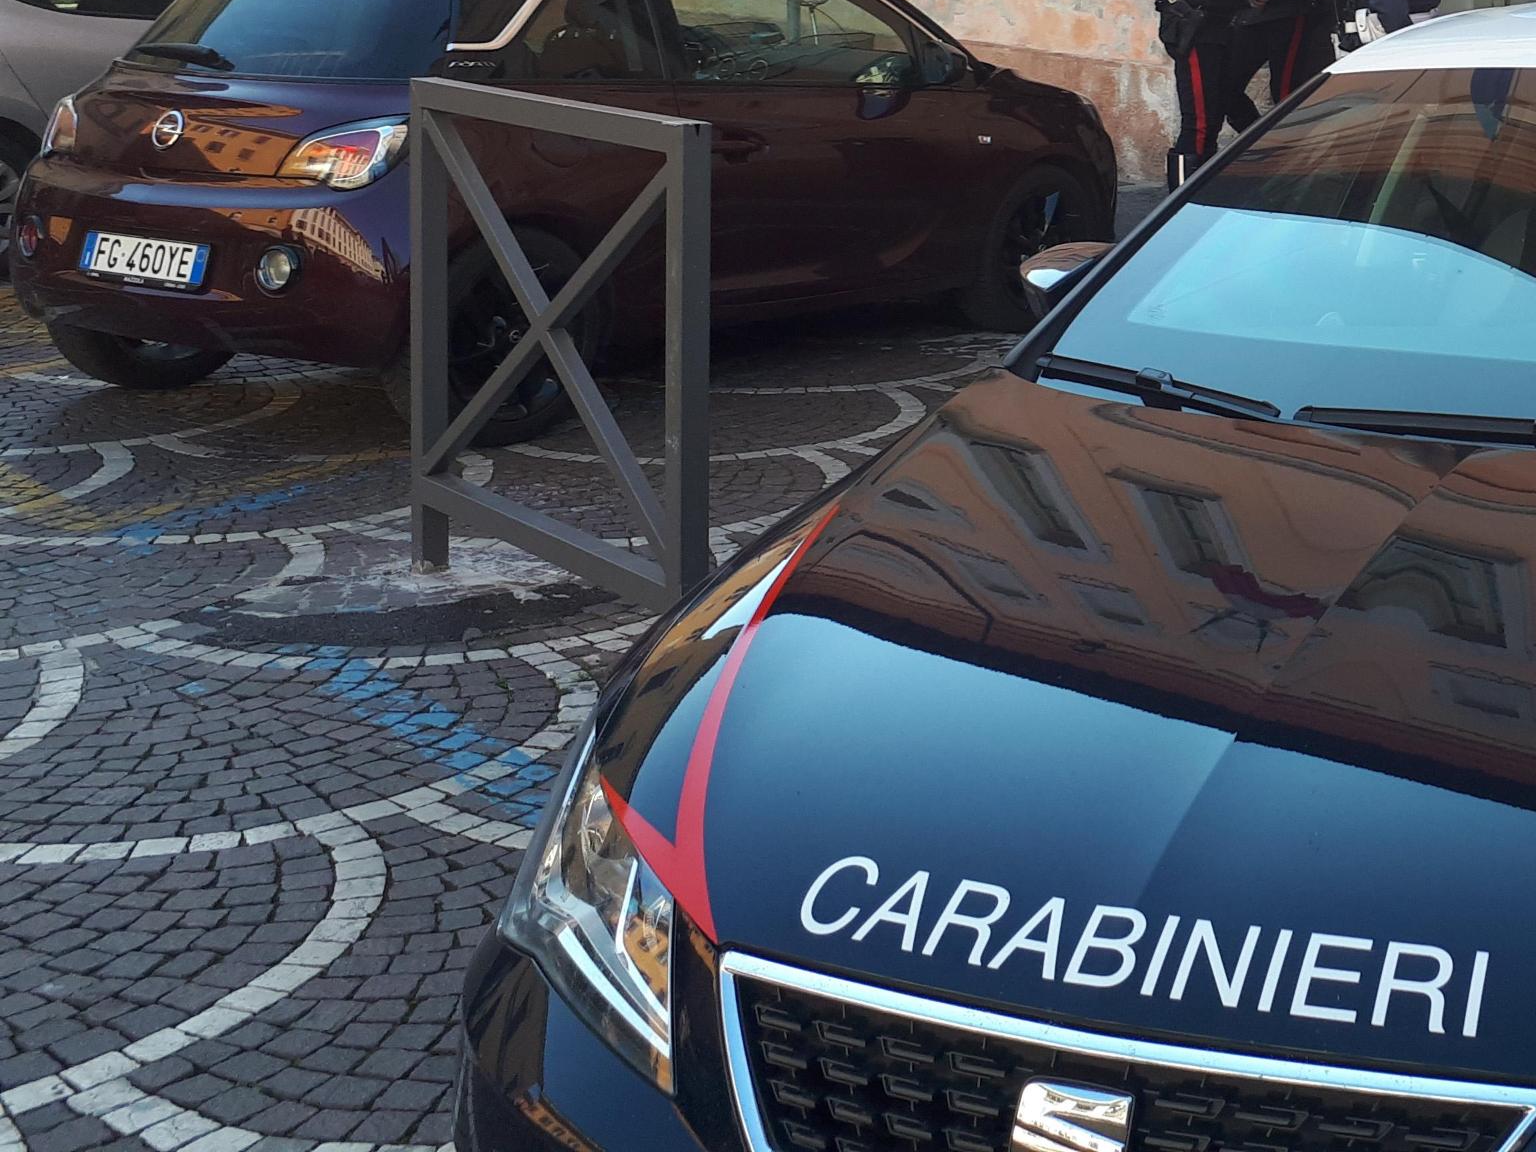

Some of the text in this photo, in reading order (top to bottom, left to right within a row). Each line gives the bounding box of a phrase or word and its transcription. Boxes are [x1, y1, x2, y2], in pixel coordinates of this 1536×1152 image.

[94, 237, 194, 279] FG 460YE
[799, 855, 1489, 1038] CARABINIERI
